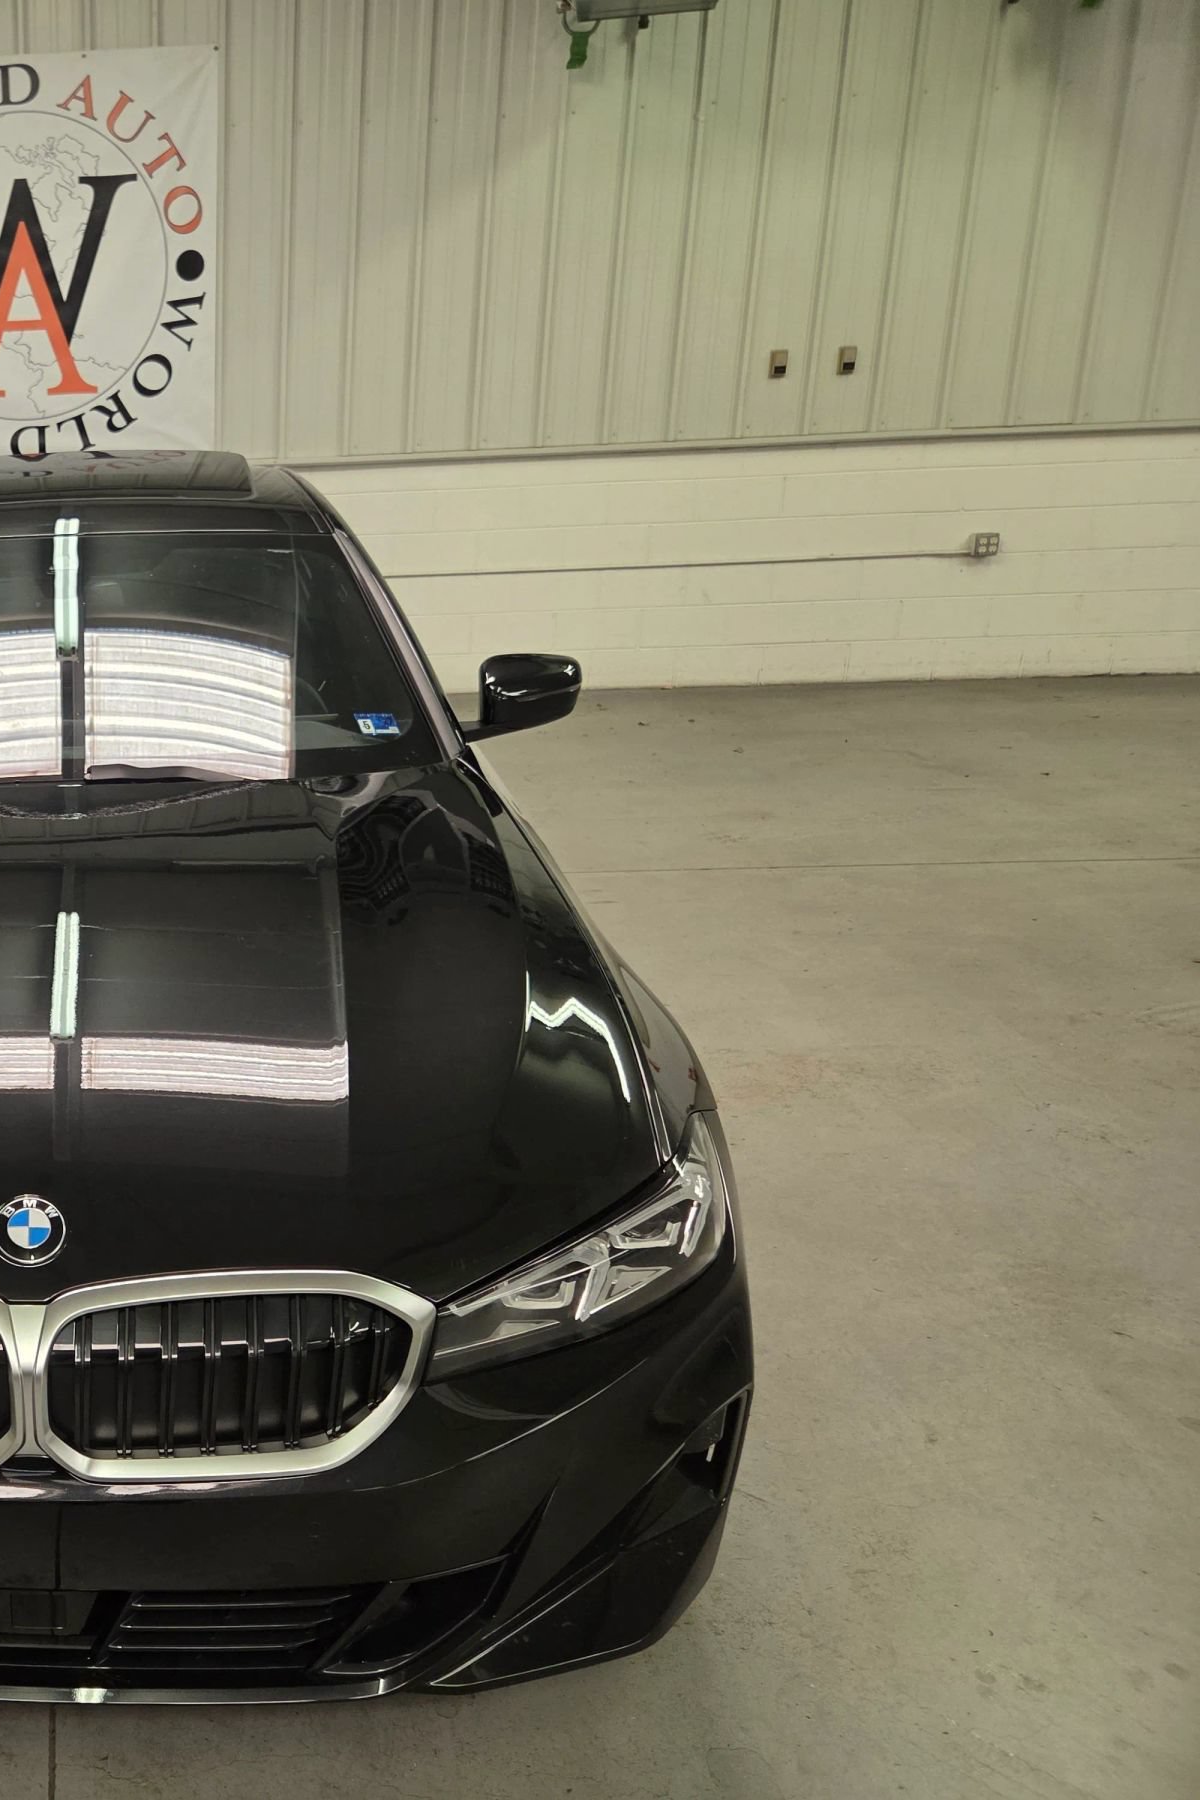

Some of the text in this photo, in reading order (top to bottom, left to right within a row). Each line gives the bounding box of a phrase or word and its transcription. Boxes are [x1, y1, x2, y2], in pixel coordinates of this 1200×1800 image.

[56, 73, 203, 235] AUTO
[9, 291, 207, 457] WORLD
[0, 1199, 59, 1218] BMW
